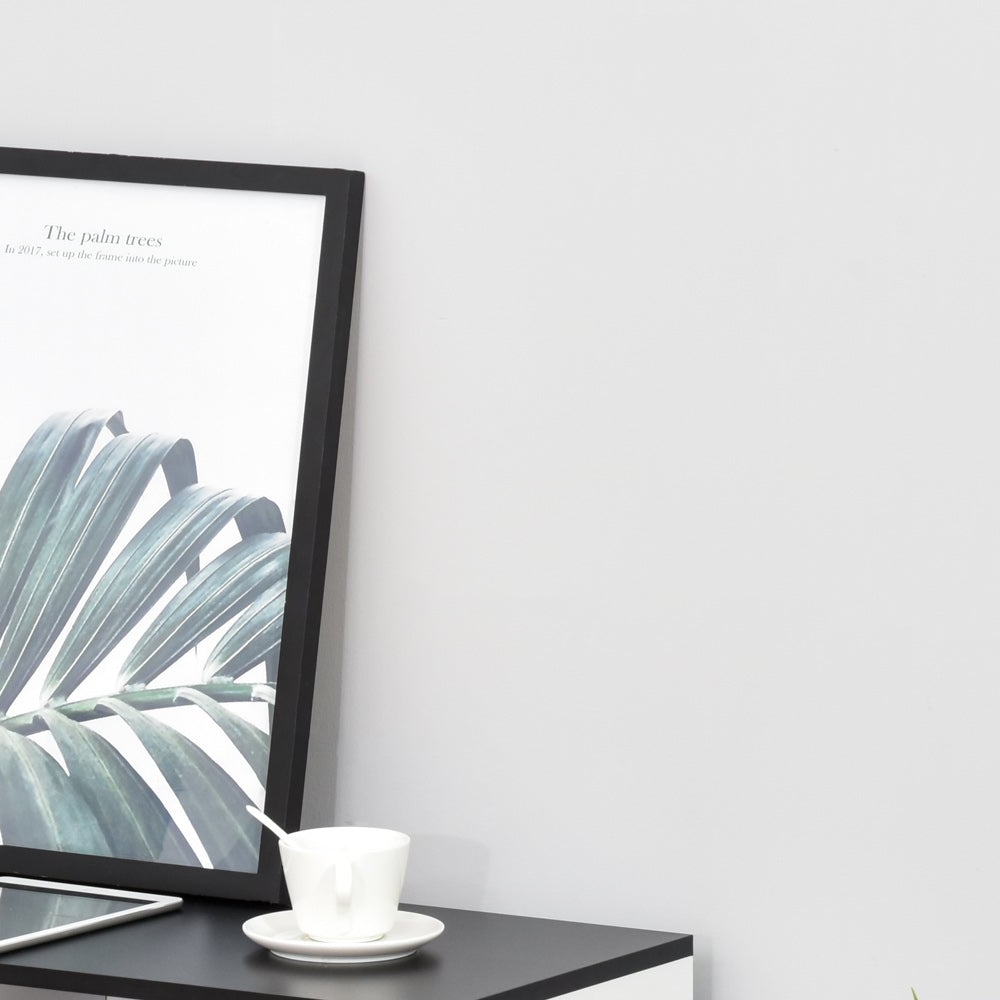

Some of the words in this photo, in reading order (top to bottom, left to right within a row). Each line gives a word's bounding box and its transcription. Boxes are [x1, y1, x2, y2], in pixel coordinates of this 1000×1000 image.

[43, 224, 76, 242] The
[80, 229, 120, 246] palm
[125, 233, 163, 248] trees
[4, 244, 15, 254] In
[18, 245, 44, 257] 2017,
[47, 249, 60, 258] set
[62, 251, 75, 260] up
[77, 249, 93, 260] the
[94, 250, 123, 262] frame
[125, 252, 145, 264] into
[146, 254, 162, 265] the
[163, 256, 198, 268] picture
